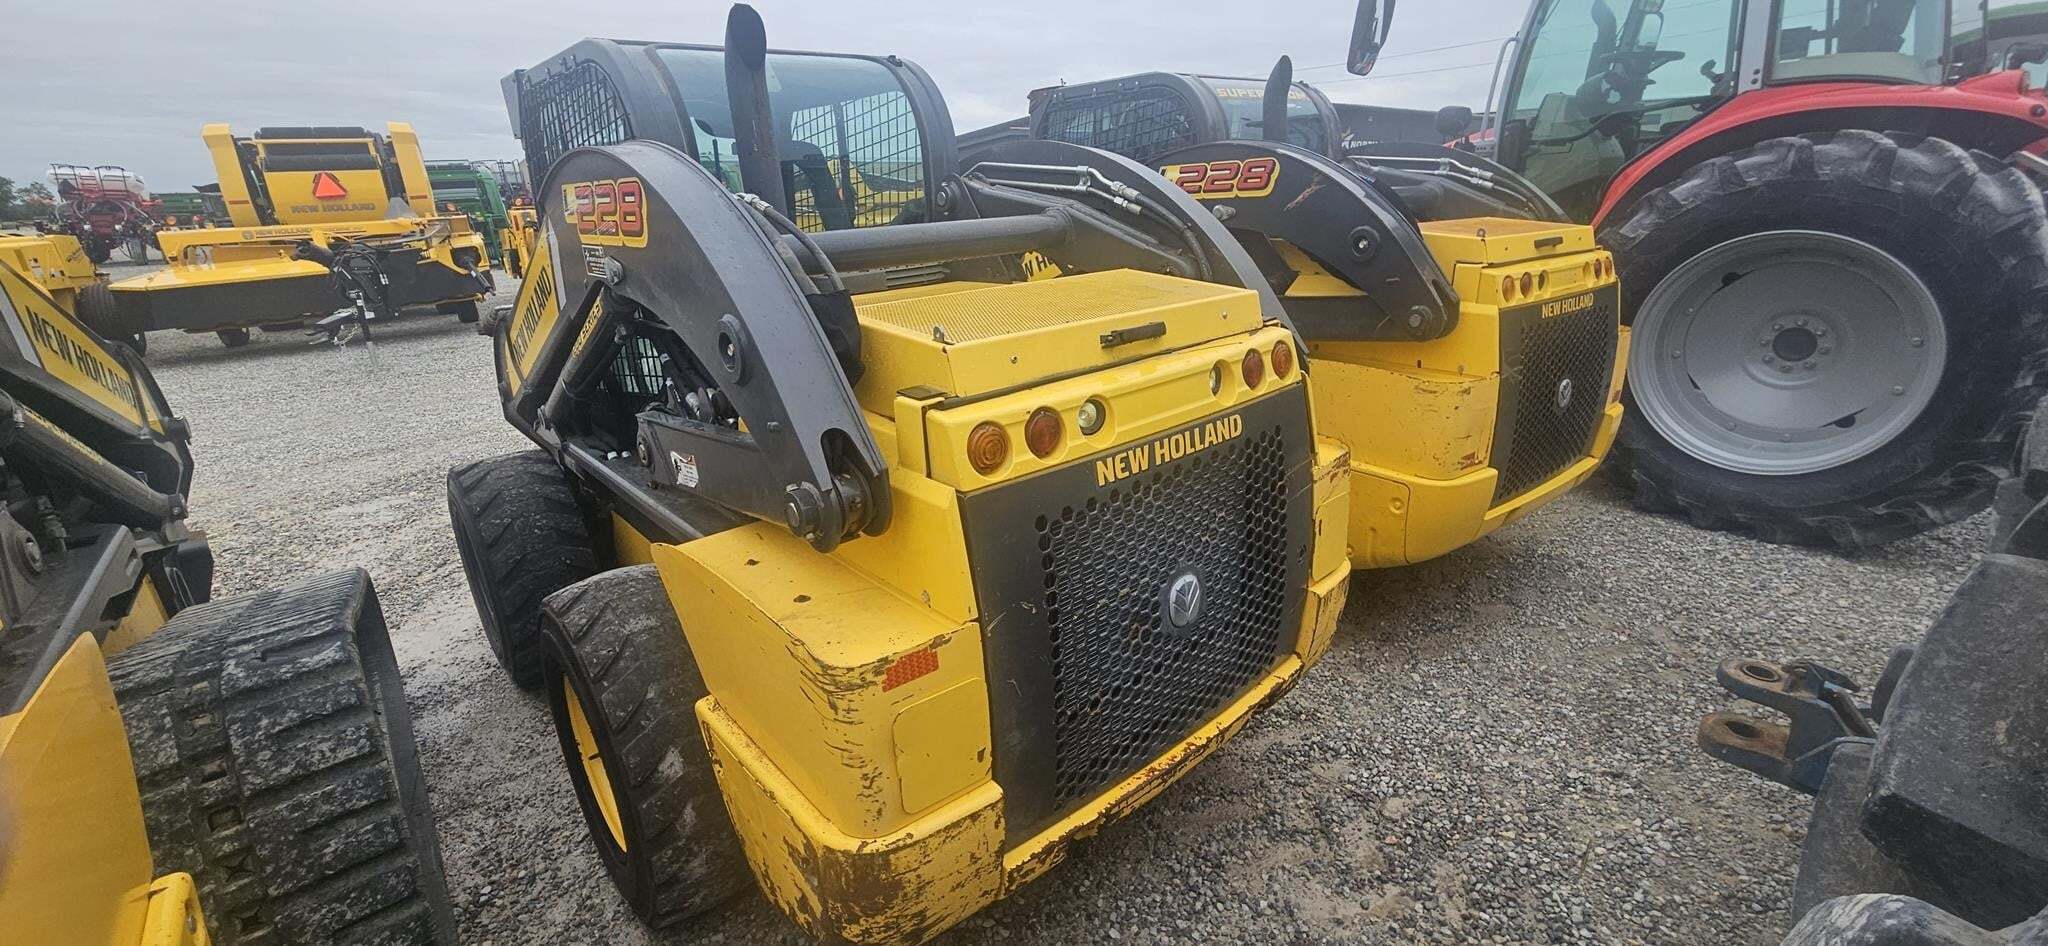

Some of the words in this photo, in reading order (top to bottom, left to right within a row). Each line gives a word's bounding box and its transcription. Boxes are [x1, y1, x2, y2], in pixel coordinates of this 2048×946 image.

[290, 206, 319, 214] NEW
[323, 202, 376, 213] HOLLAND
[511, 324, 530, 367] NEW
[522, 265, 552, 343] HOLLAND
[1542, 302, 1561, 319] NEW
[1561, 293, 1594, 313] HOLLAND
[25, 304, 74, 366] NEW
[71, 339, 138, 410] HOLLAND
[1096, 444, 1150, 487] NEW
[1154, 414, 1243, 466] HOLLAND
